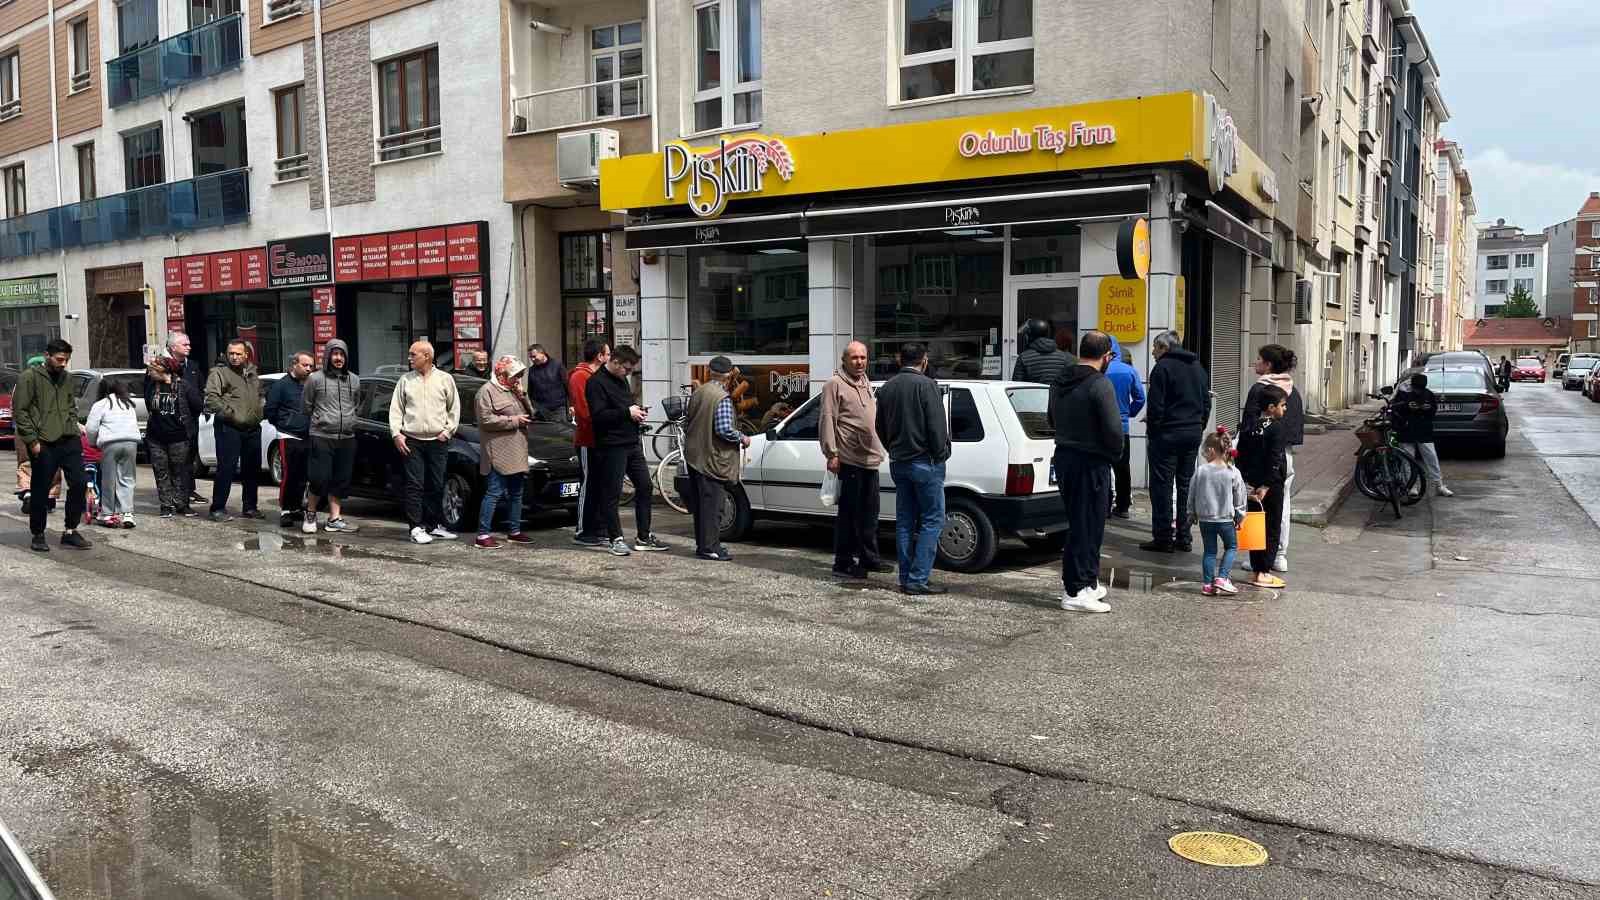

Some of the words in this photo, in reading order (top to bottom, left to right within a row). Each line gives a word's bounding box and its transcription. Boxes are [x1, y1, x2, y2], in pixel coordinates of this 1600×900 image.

[960, 128, 1032, 157] Odunlu
[1033, 124, 1066, 153] Taş
[1069, 120, 1115, 147] Fırın
[1109, 286, 1136, 298] Simit
[1105, 303, 1137, 316] Börek
[1103, 320, 1137, 333] Ekmek
